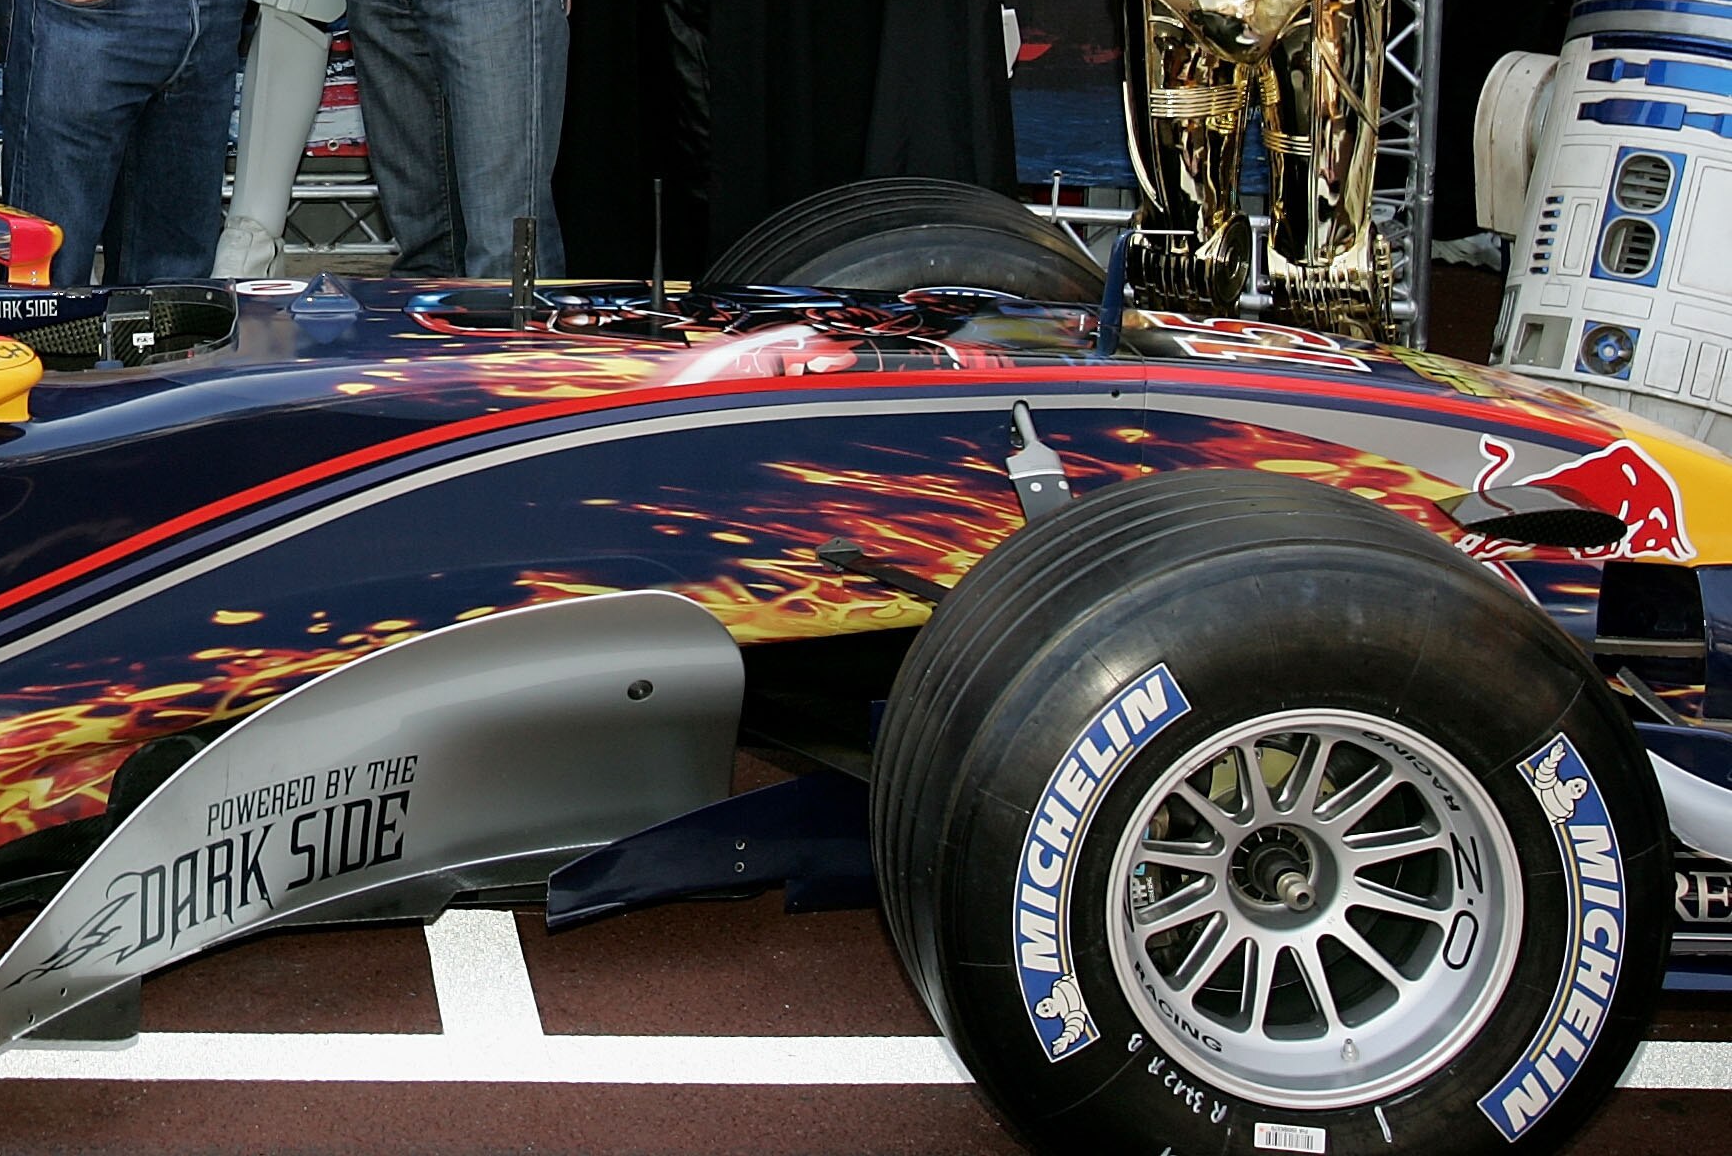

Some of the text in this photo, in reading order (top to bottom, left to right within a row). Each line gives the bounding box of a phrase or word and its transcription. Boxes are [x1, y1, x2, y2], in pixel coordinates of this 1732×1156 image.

[25, 299, 58, 318] SIDE
[207, 755, 418, 836] POWERED BY THE
[1362, 731, 1462, 812] RACING
[1020, 674, 1168, 973] MICHELIN
[114, 790, 410, 964] DARK SIDE
[1134, 961, 1223, 1053] RACING
[1501, 825, 1620, 1132] MICHELIN
